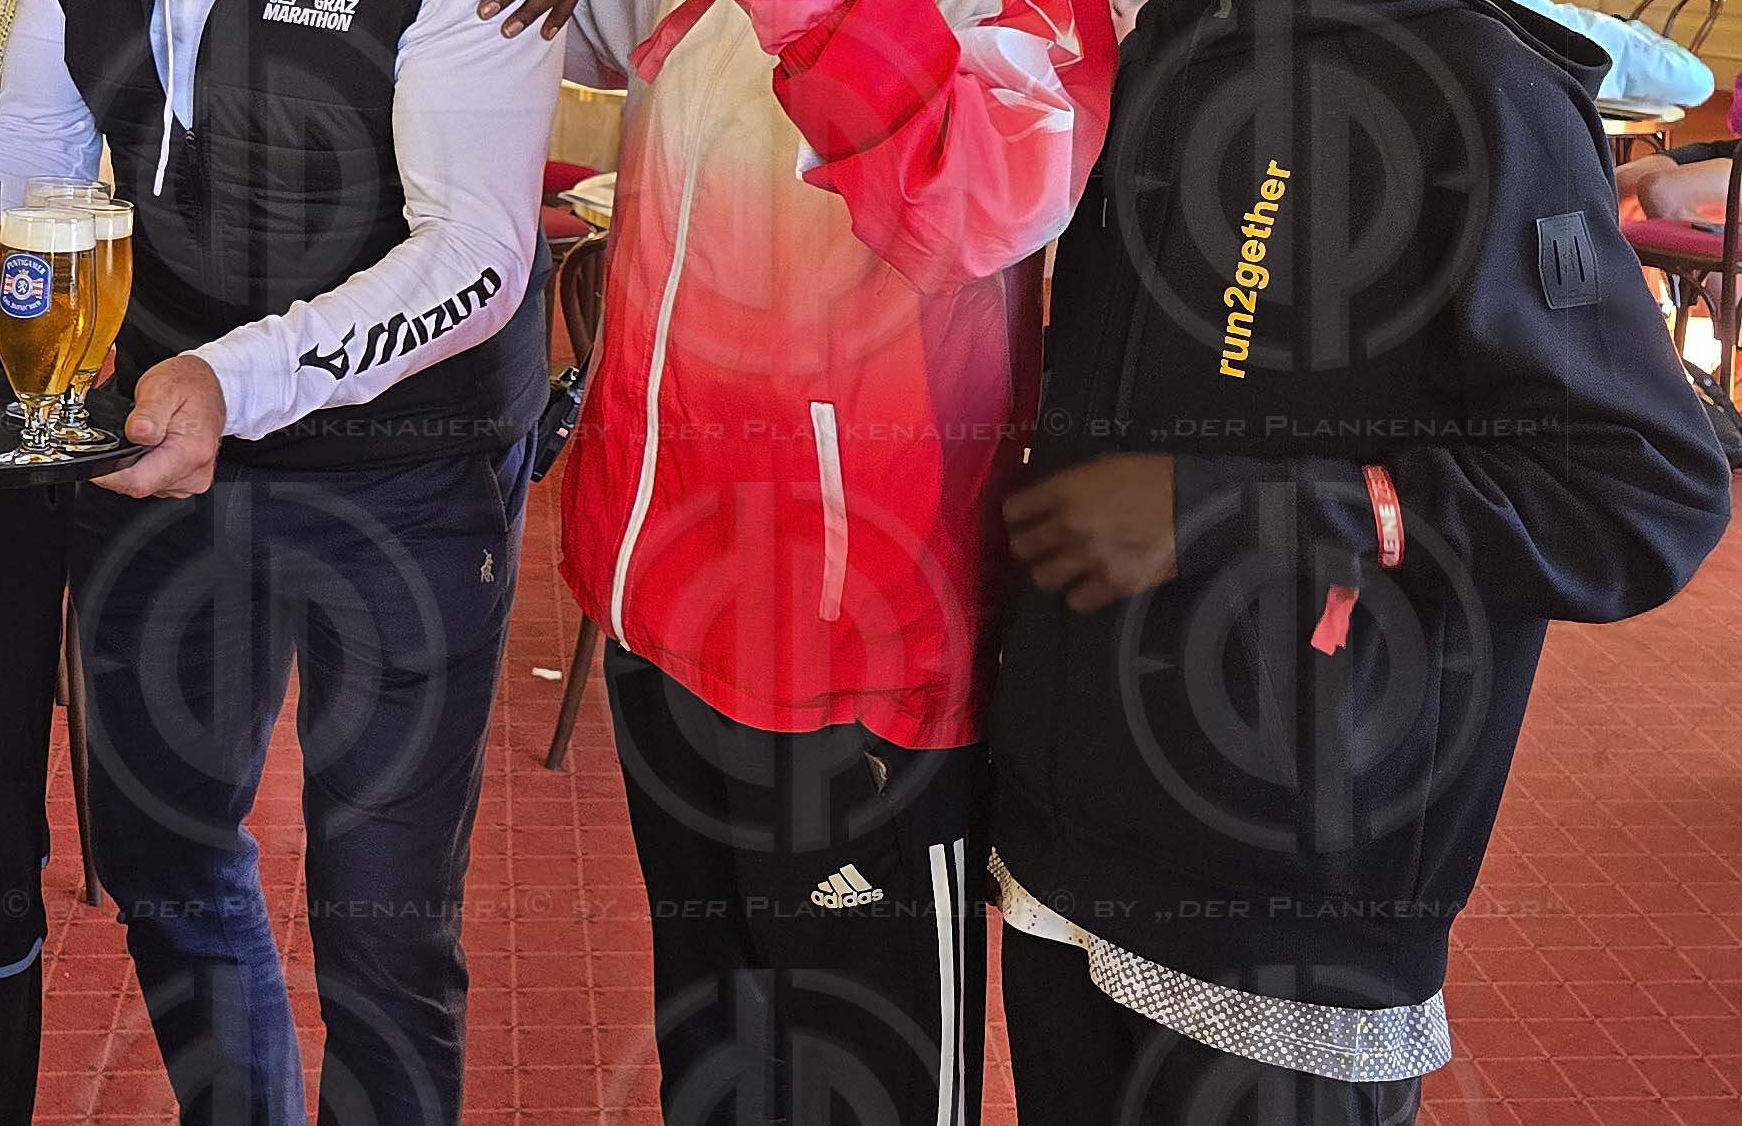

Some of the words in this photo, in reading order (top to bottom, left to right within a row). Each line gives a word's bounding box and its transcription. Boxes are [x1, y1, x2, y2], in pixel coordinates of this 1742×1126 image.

[263, 3, 353, 31] MARATHON
[1219, 160, 1291, 378] run2gether
[811, 888, 884, 909] adidas
